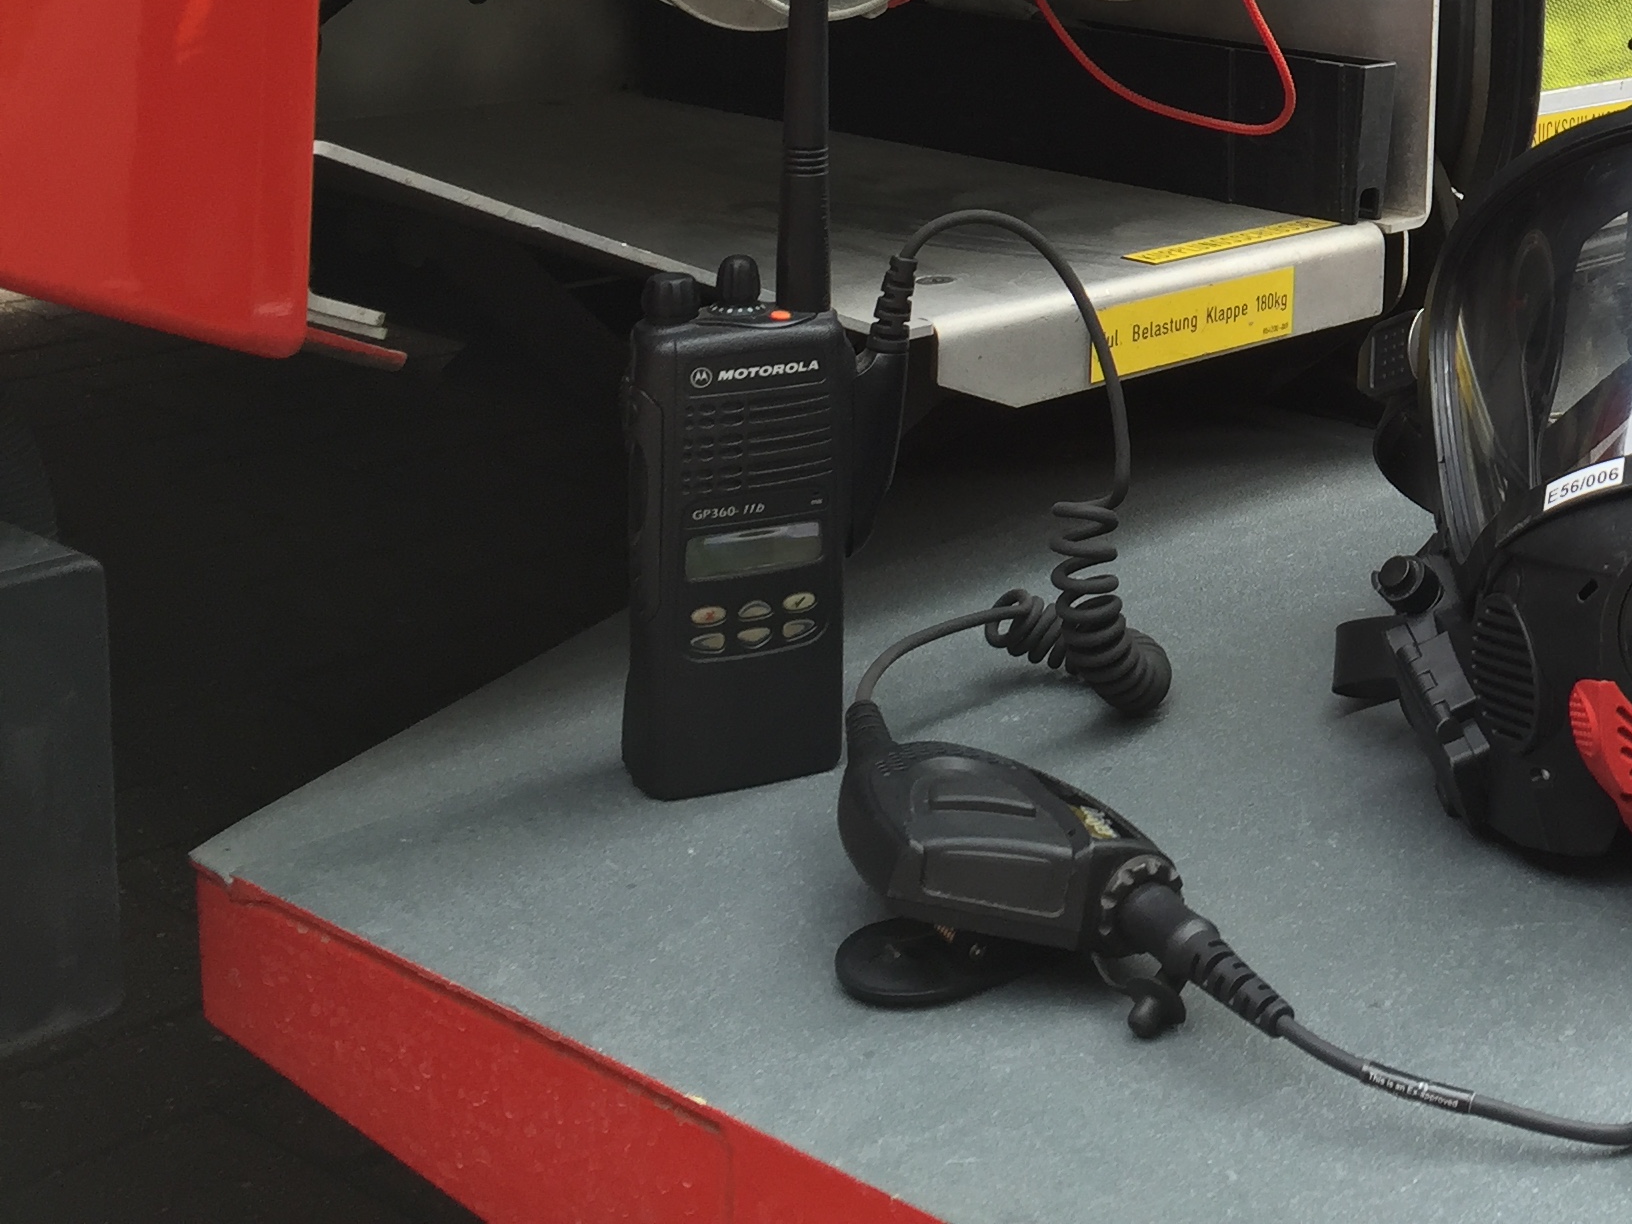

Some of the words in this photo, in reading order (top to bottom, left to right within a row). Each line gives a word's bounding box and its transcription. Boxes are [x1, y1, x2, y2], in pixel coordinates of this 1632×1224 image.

[1104, 329, 1122, 349] ul.
[1132, 314, 1198, 343] Belastung
[1206, 302, 1249, 325] Klappe
[1256, 292, 1288, 313] 180kg
[717, 359, 820, 382] MOTOROLA
[1547, 467, 1620, 505] E56/006
[1386, 1078, 1394, 1089] is
[1419, 1090, 1460, 1109] approved
